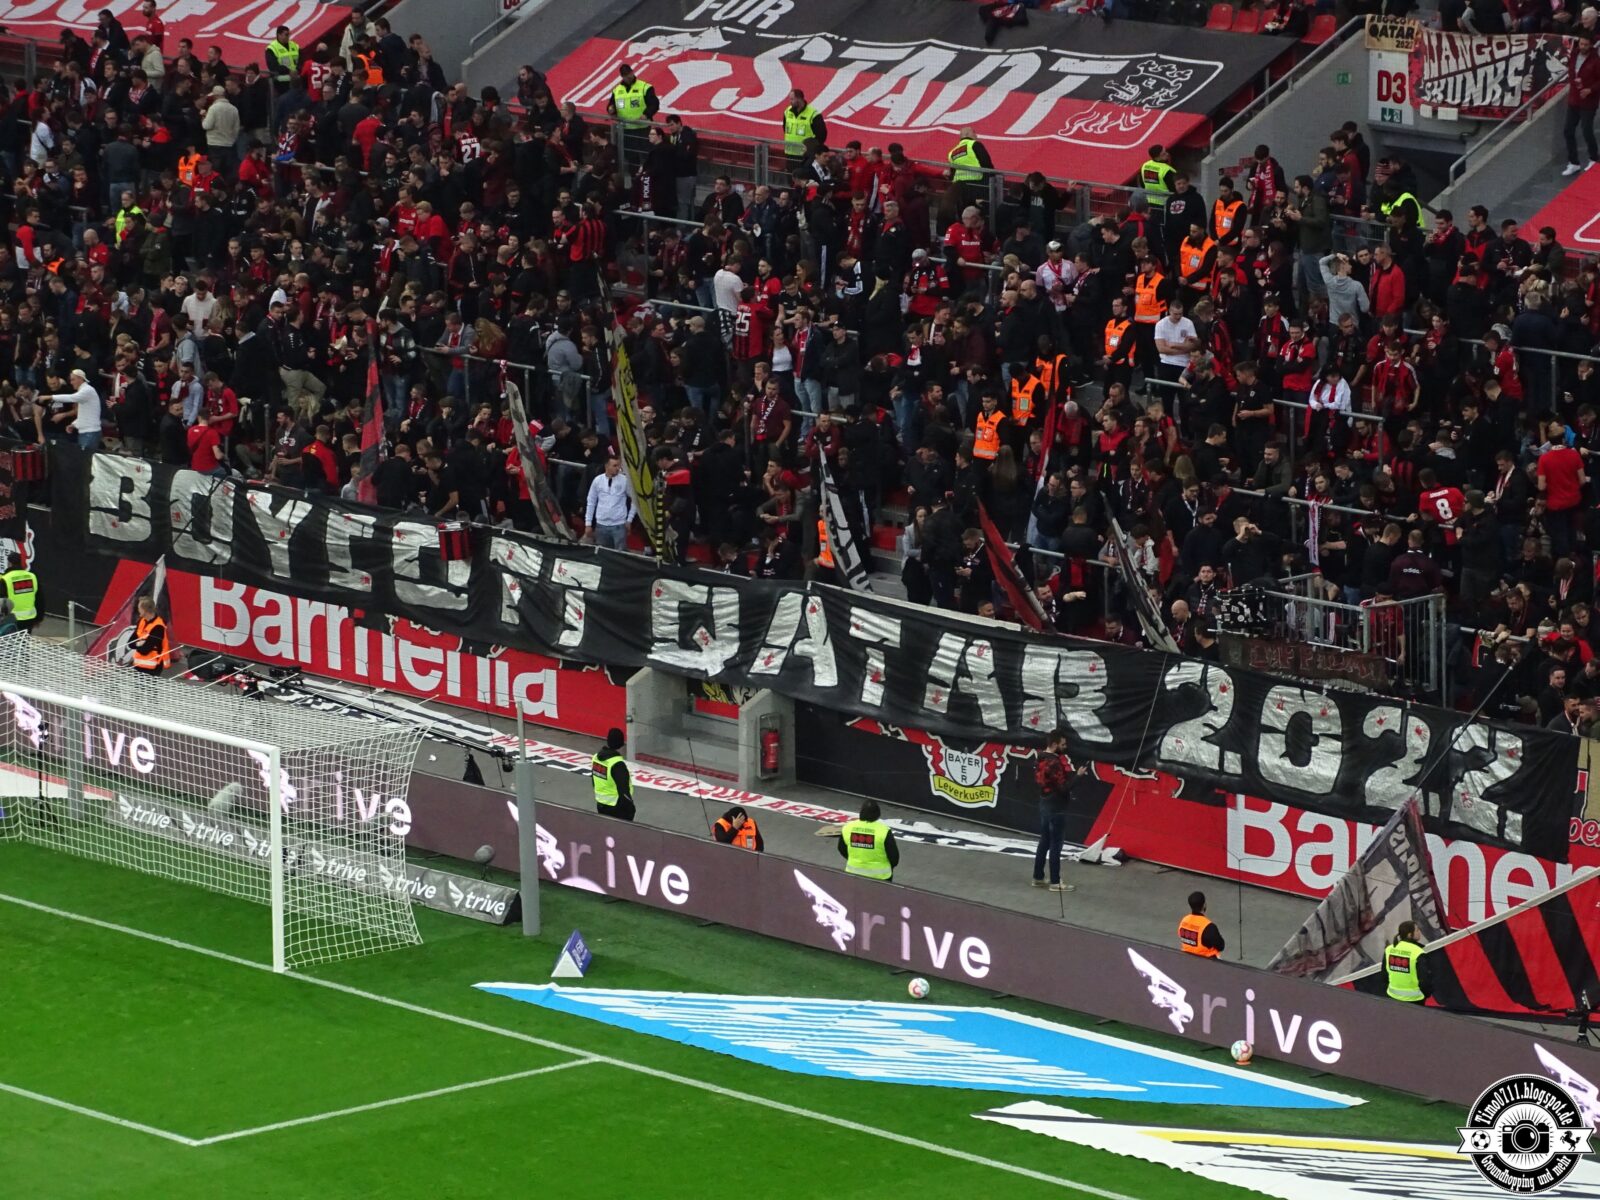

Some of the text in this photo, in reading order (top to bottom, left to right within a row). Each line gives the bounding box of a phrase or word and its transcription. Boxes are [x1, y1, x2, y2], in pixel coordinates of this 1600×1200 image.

[1369, 24, 1415, 42] QATAR
[711, 37, 1130, 136] STADT
[1377, 70, 1407, 104] D3
[461, 142, 480, 163] 27
[1436, 498, 1453, 520] 8
[646, 578, 1113, 743] QATAR
[947, 753, 981, 768] BAYER
[938, 779, 990, 800] Leverkusen
[133, 804, 170, 829] trive
[196, 822, 233, 846] trive
[328, 859, 367, 882] trive
[396, 875, 437, 899] trive
[465, 891, 506, 916] trive
